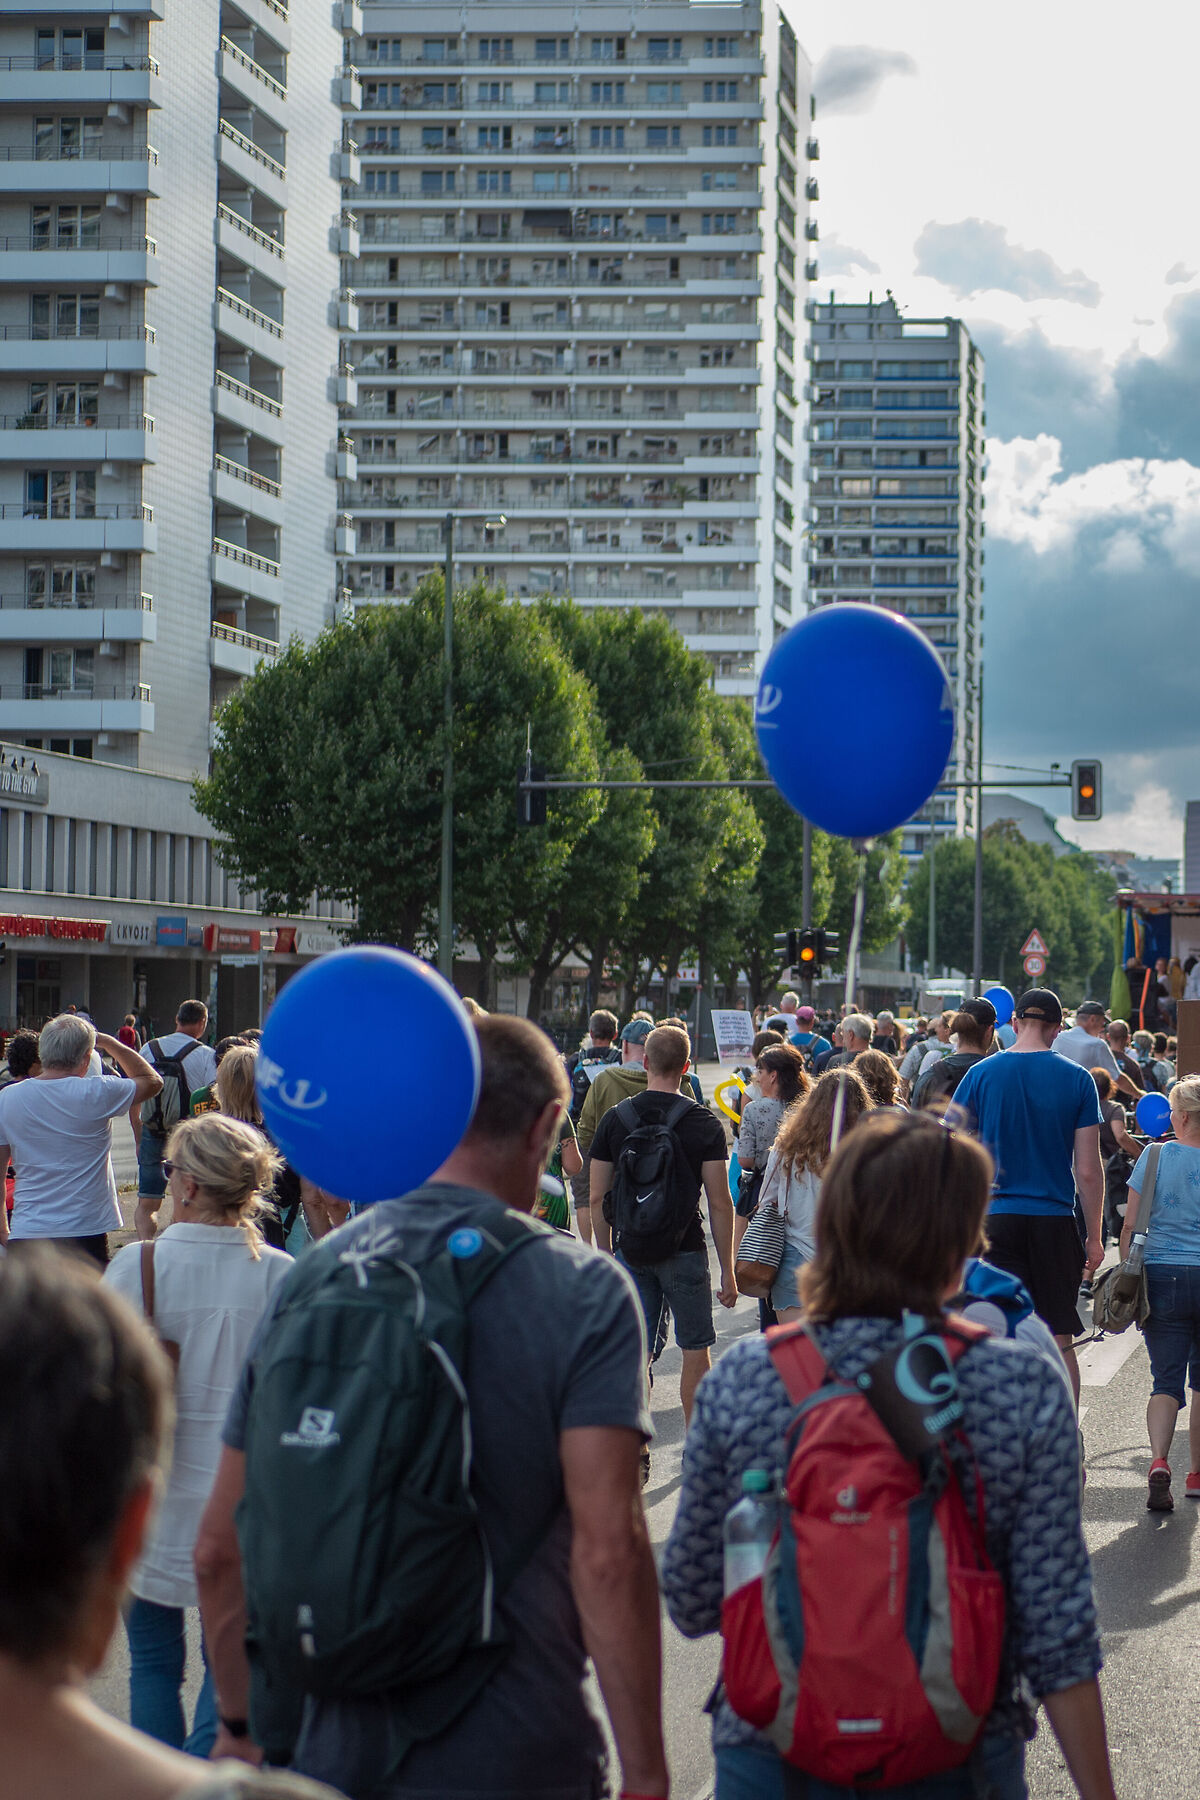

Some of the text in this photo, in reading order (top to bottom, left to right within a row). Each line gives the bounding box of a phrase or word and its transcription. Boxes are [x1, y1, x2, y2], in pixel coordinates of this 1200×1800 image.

[2, 771, 37, 795] TO THE GYM
[1029, 961, 1041, 970] 30
